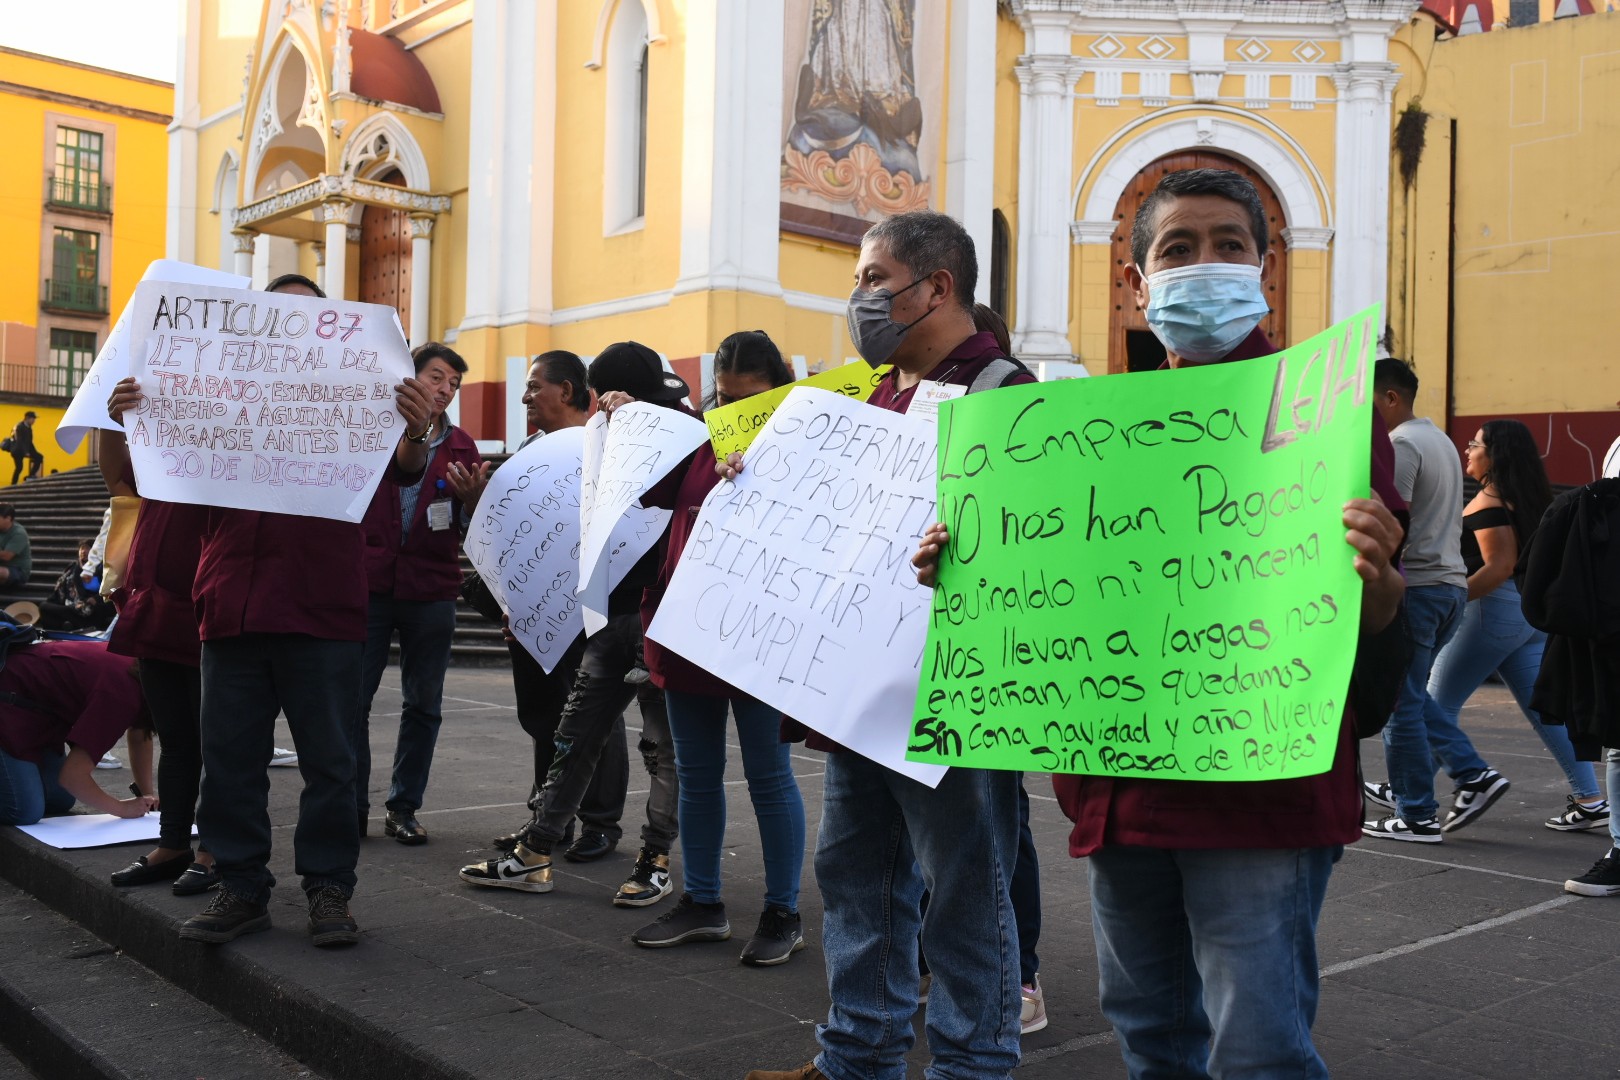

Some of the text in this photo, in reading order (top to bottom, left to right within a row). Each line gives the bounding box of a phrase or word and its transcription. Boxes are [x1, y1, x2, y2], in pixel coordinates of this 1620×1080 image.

[153, 295, 363, 342] ARTICULO 87
[148, 335, 212, 372] LEY
[219, 340, 327, 373] FEDERAL
[340, 347, 382, 373] DEL
[135, 394, 395, 430] DERECHO A AGUINALDO
[272, 381, 367, 402] ESTABLECE
[941, 315, 1373, 482] La Empresa LEIH
[132, 417, 388, 454] A PAGARSE ANTES DEL
[161, 449, 204, 478] 20
[211, 453, 241, 481] DE
[707, 480, 804, 537] PARTE
[802, 514, 849, 554] DE
[941, 459, 1327, 566] NO nos han Pagado
[484, 520, 532, 591] Nuestro
[508, 521, 569, 593] quincena
[689, 521, 921, 647] BIENESTAR Y
[933, 533, 1320, 629] Aguinaldo ni quincena
[514, 570, 571, 635] Podemos
[695, 583, 846, 695] CUMPLE
[931, 637, 984, 682] Nos
[1002, 626, 1092, 668] llevan
[1106, 630, 1139, 657] a
[1286, 594, 1338, 635] nos
[928, 658, 1311, 716] engañan, nos quedamos
[908, 717, 962, 757] Sin
[1043, 712, 1151, 746] navidad
[1192, 708, 1252, 735] año
[1263, 695, 1334, 734] Nuevo
[1030, 746, 1089, 771] Sin
[1195, 744, 1232, 772] de
[1243, 733, 1316, 773] Reyes
